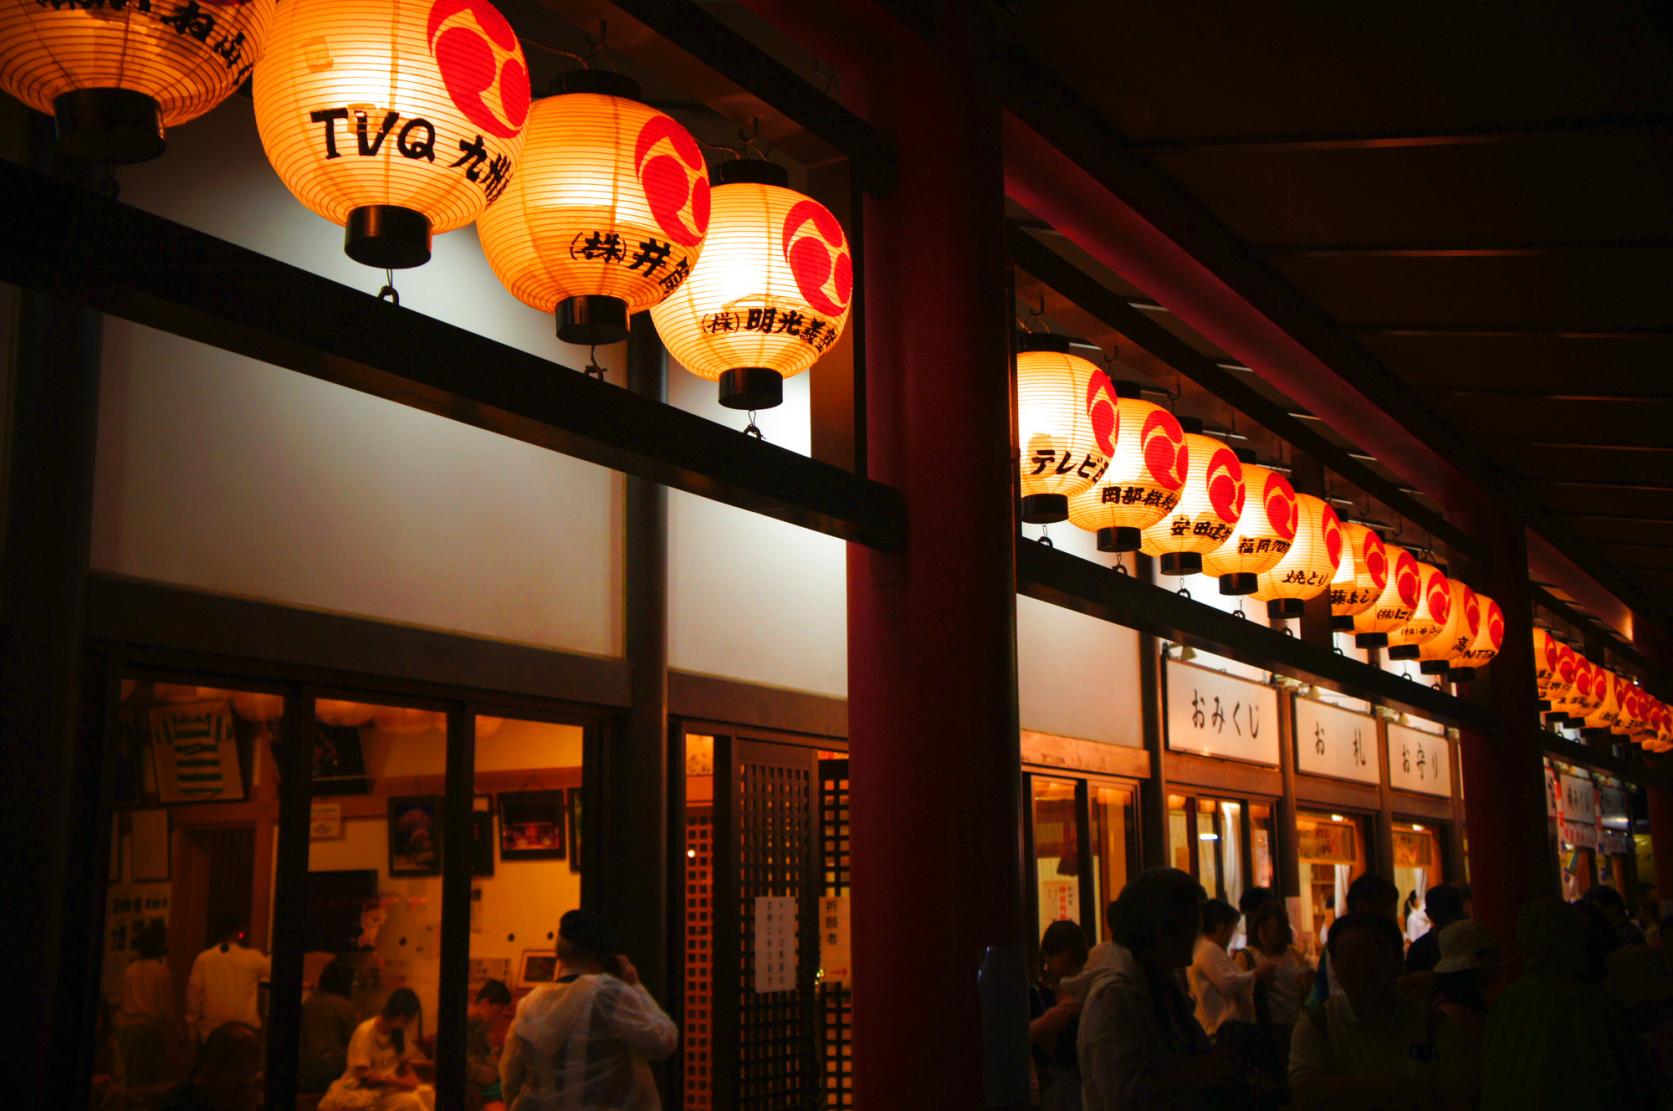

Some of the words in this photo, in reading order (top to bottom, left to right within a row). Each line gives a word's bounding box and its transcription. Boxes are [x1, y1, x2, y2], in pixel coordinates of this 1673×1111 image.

[309, 107, 437, 163] TVQ
[1331, 588, 1380, 607] 藤よし
[1191, 688, 1260, 739] おみくじ
[1401, 741, 1439, 780] お守り
